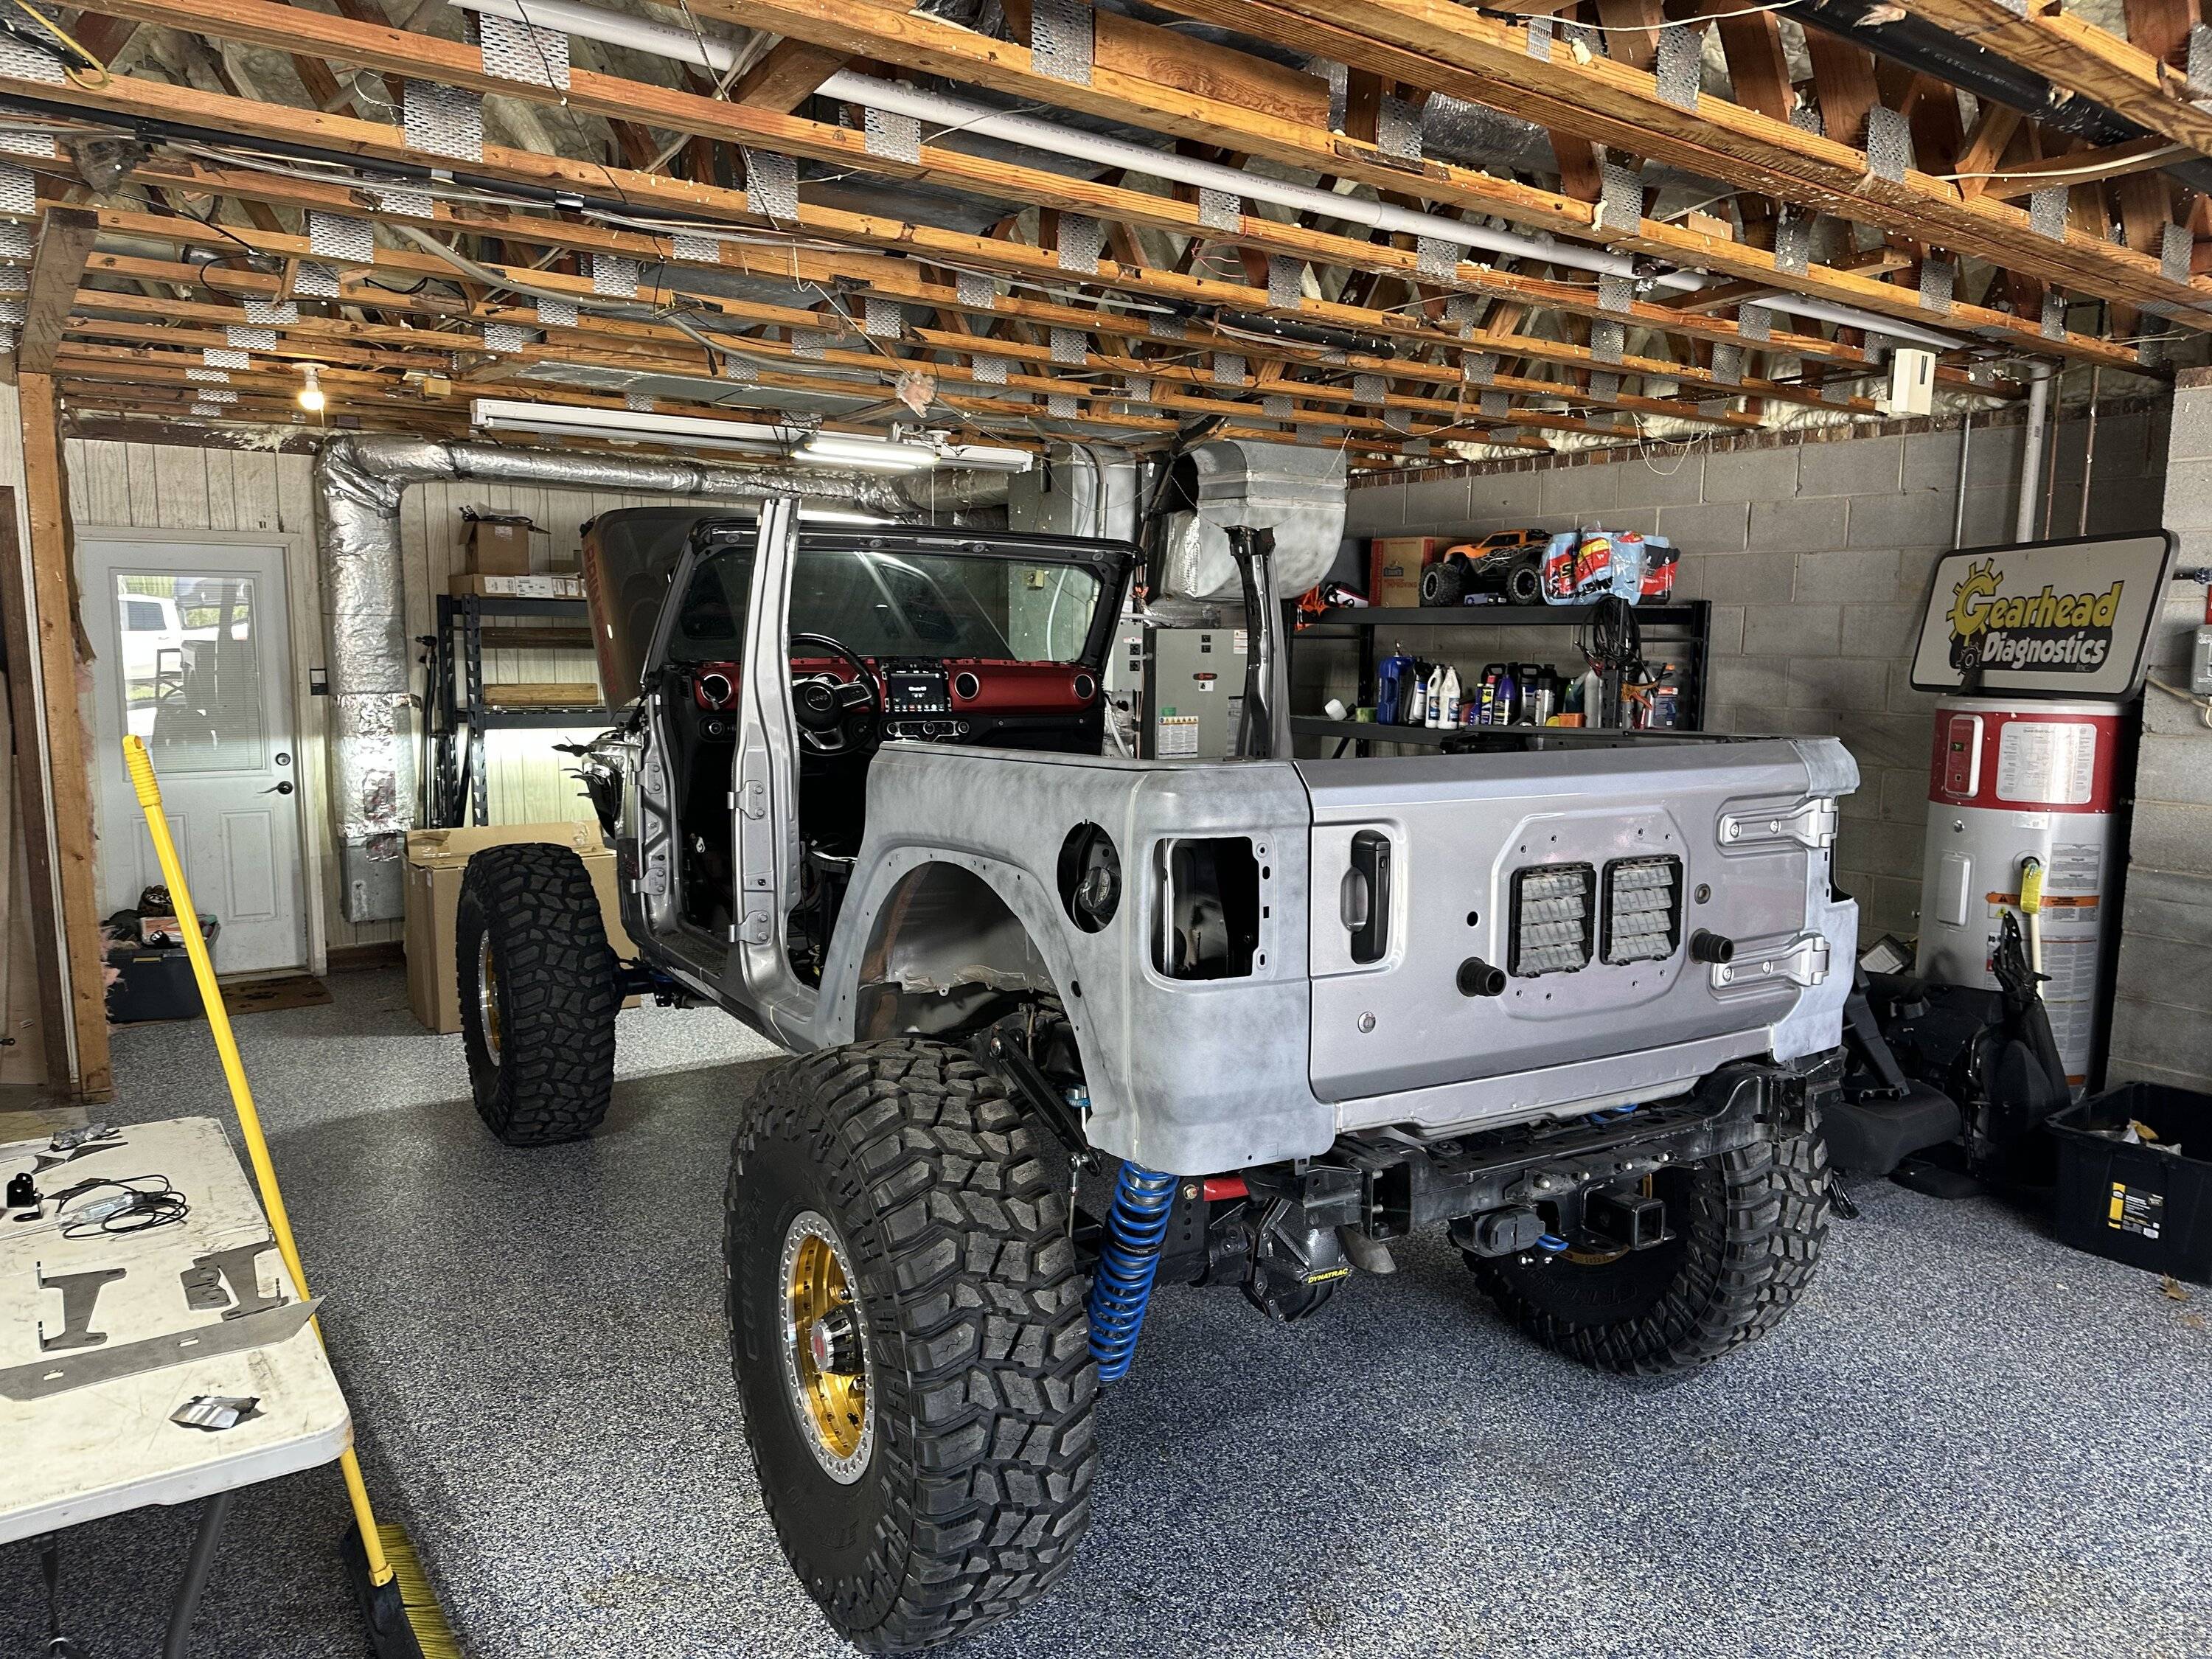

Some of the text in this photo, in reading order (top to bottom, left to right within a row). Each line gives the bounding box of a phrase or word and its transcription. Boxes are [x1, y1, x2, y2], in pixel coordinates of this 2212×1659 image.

[1947, 558, 2125, 641] Gearhead
[1981, 631, 2107, 669] Diagnostics
[1307, 1267, 1349, 1284] DYNATRAC
